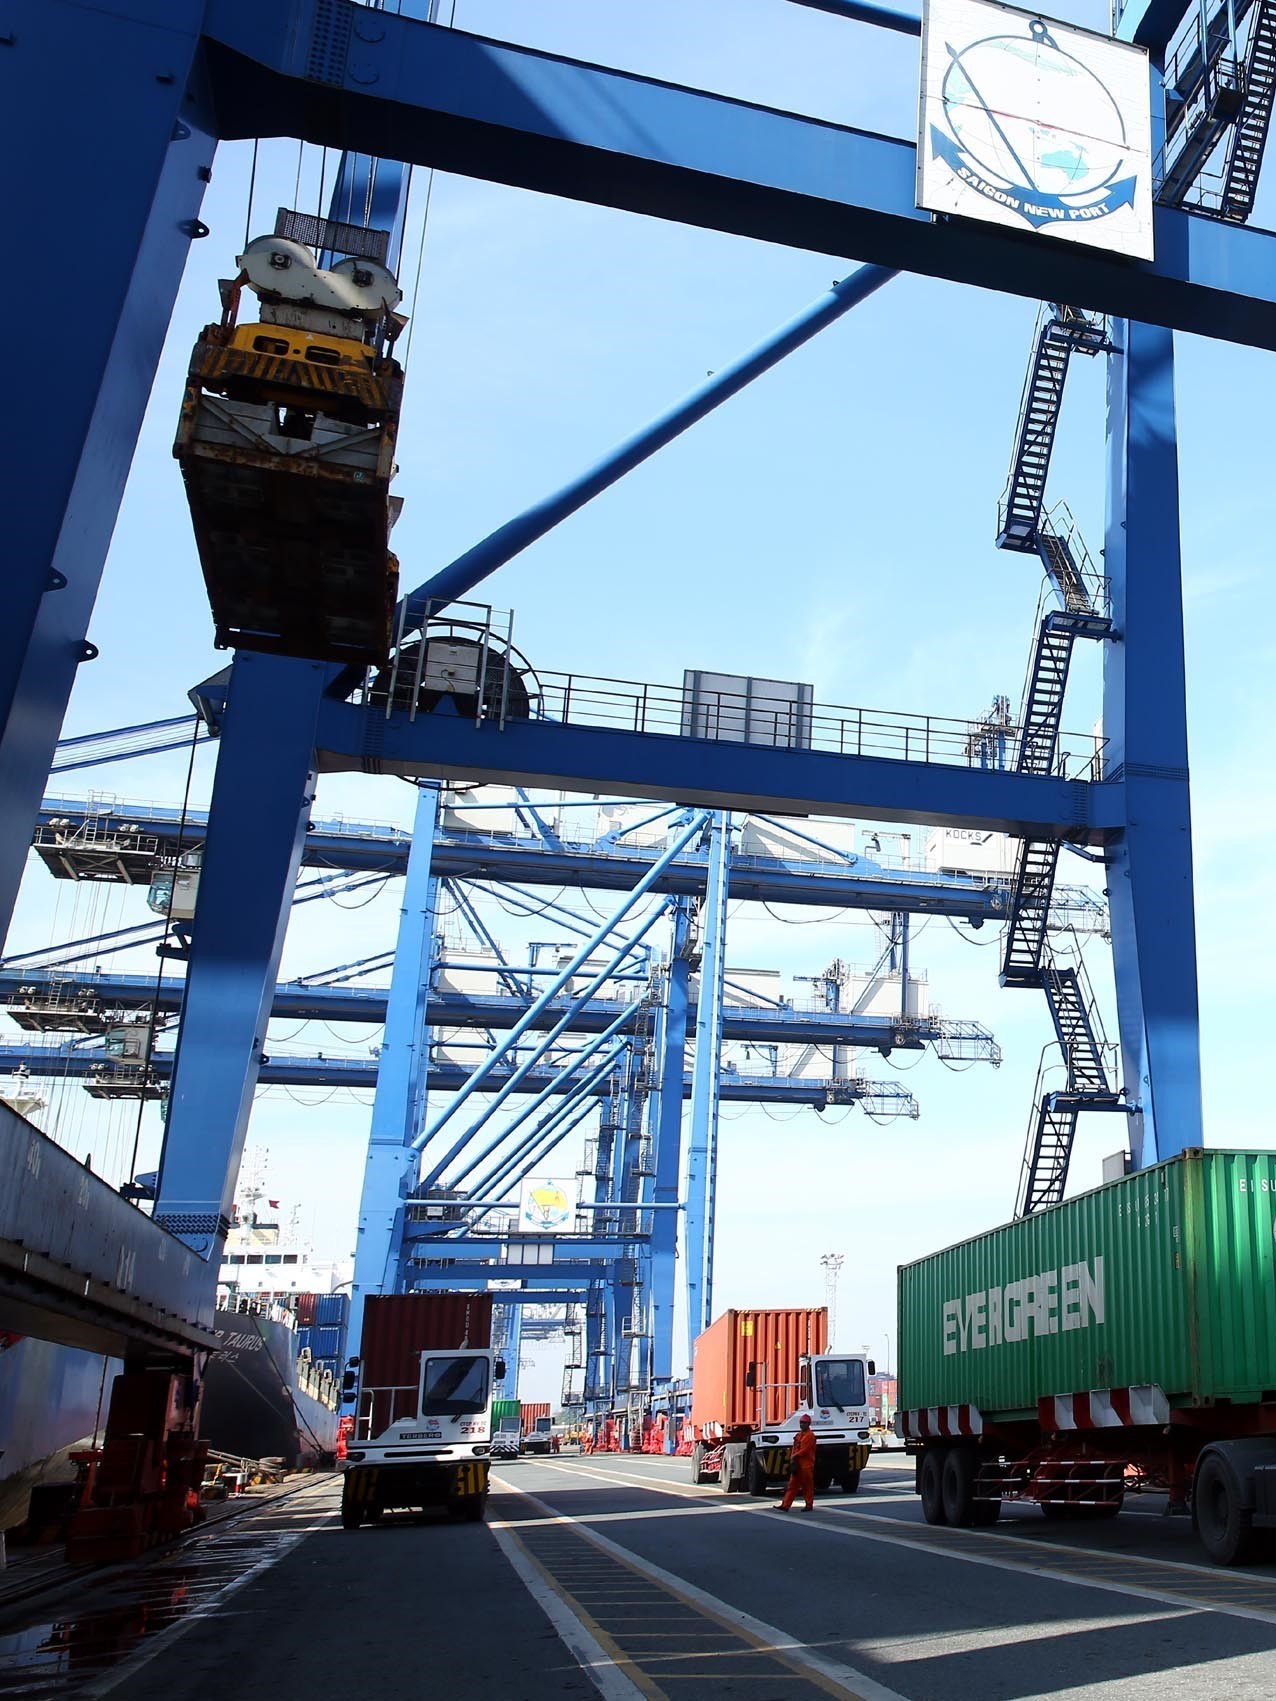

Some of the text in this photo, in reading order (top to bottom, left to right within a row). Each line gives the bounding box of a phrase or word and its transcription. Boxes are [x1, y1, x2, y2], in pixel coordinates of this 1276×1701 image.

[956, 166, 1111, 220] SAIGON NEW PORT
[945, 828, 982, 841] KOCKS
[943, 1255, 1105, 1356] EVERGREEN
[223, 1331, 267, 1352] TAURUS
[461, 1426, 486, 1434] 218
